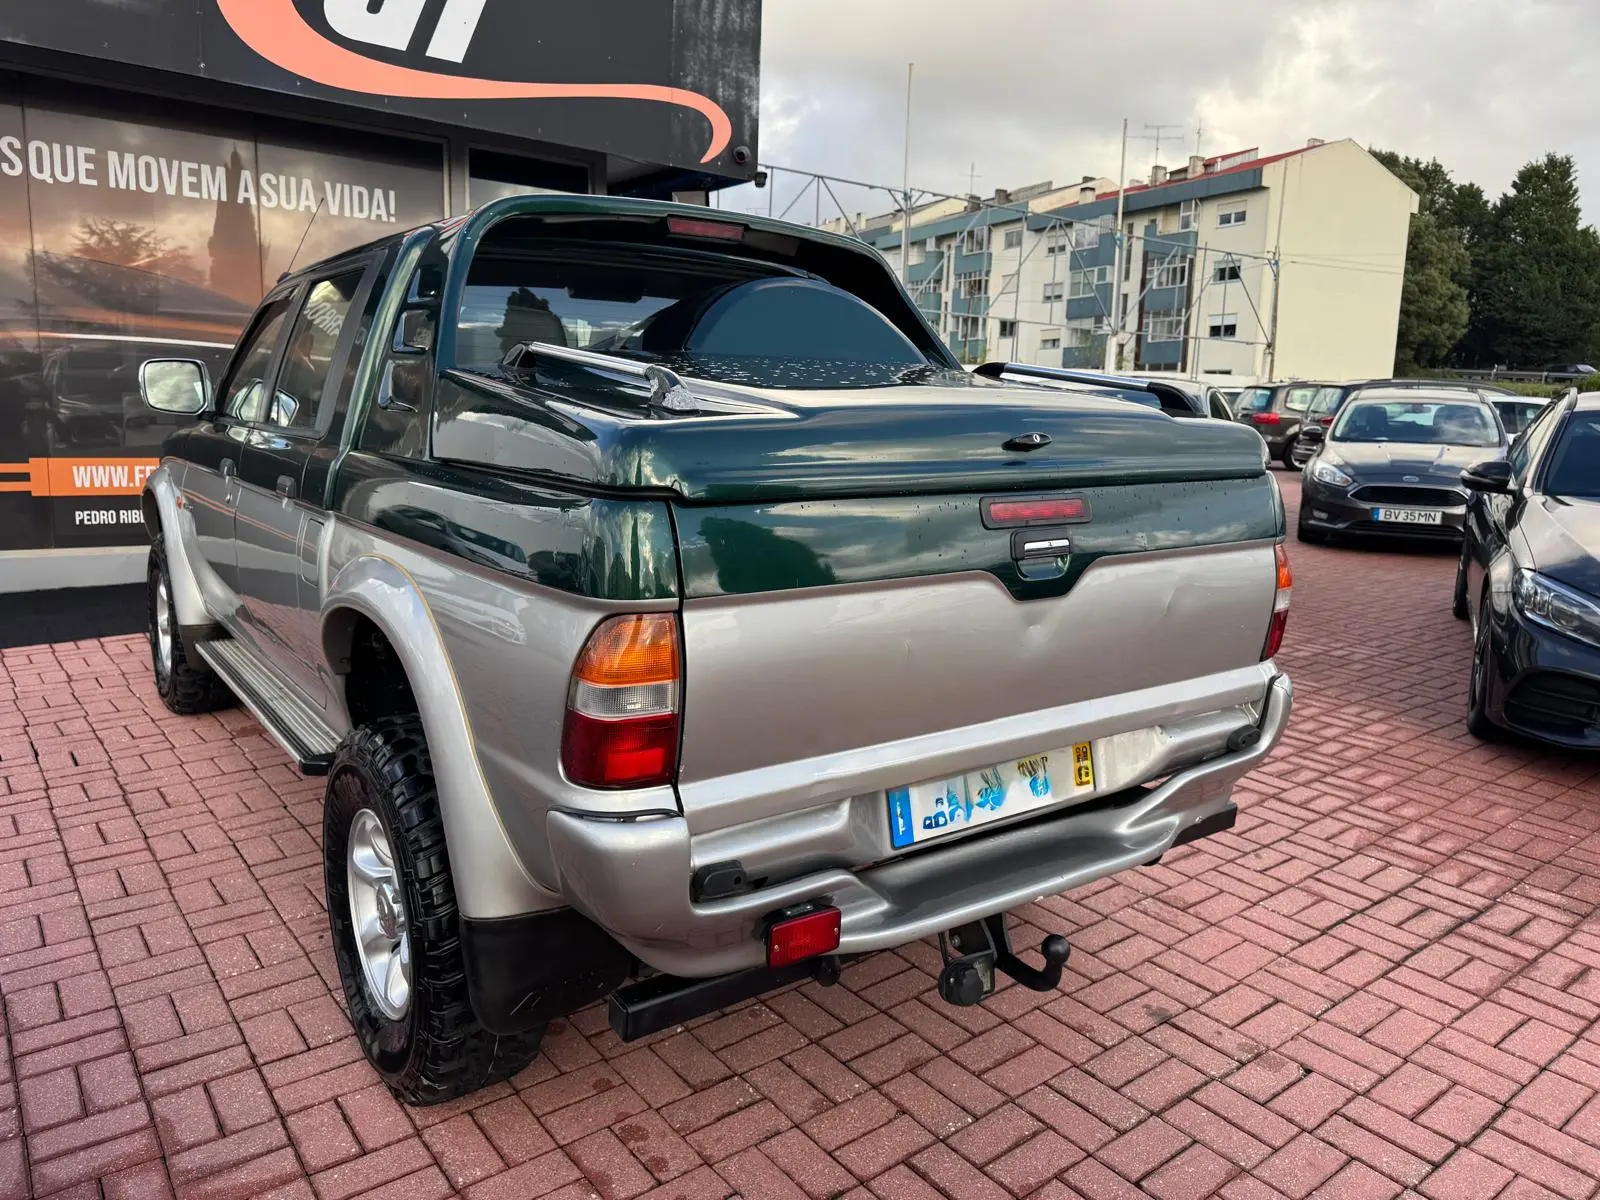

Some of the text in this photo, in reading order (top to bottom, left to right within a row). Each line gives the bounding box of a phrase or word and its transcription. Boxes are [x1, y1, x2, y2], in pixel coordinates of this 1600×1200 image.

[28, 140, 98, 186] QUE
[107, 150, 227, 202] MOVEM
[324, 181, 396, 223] VIDA!
[75, 510, 117, 525] PEDRO
